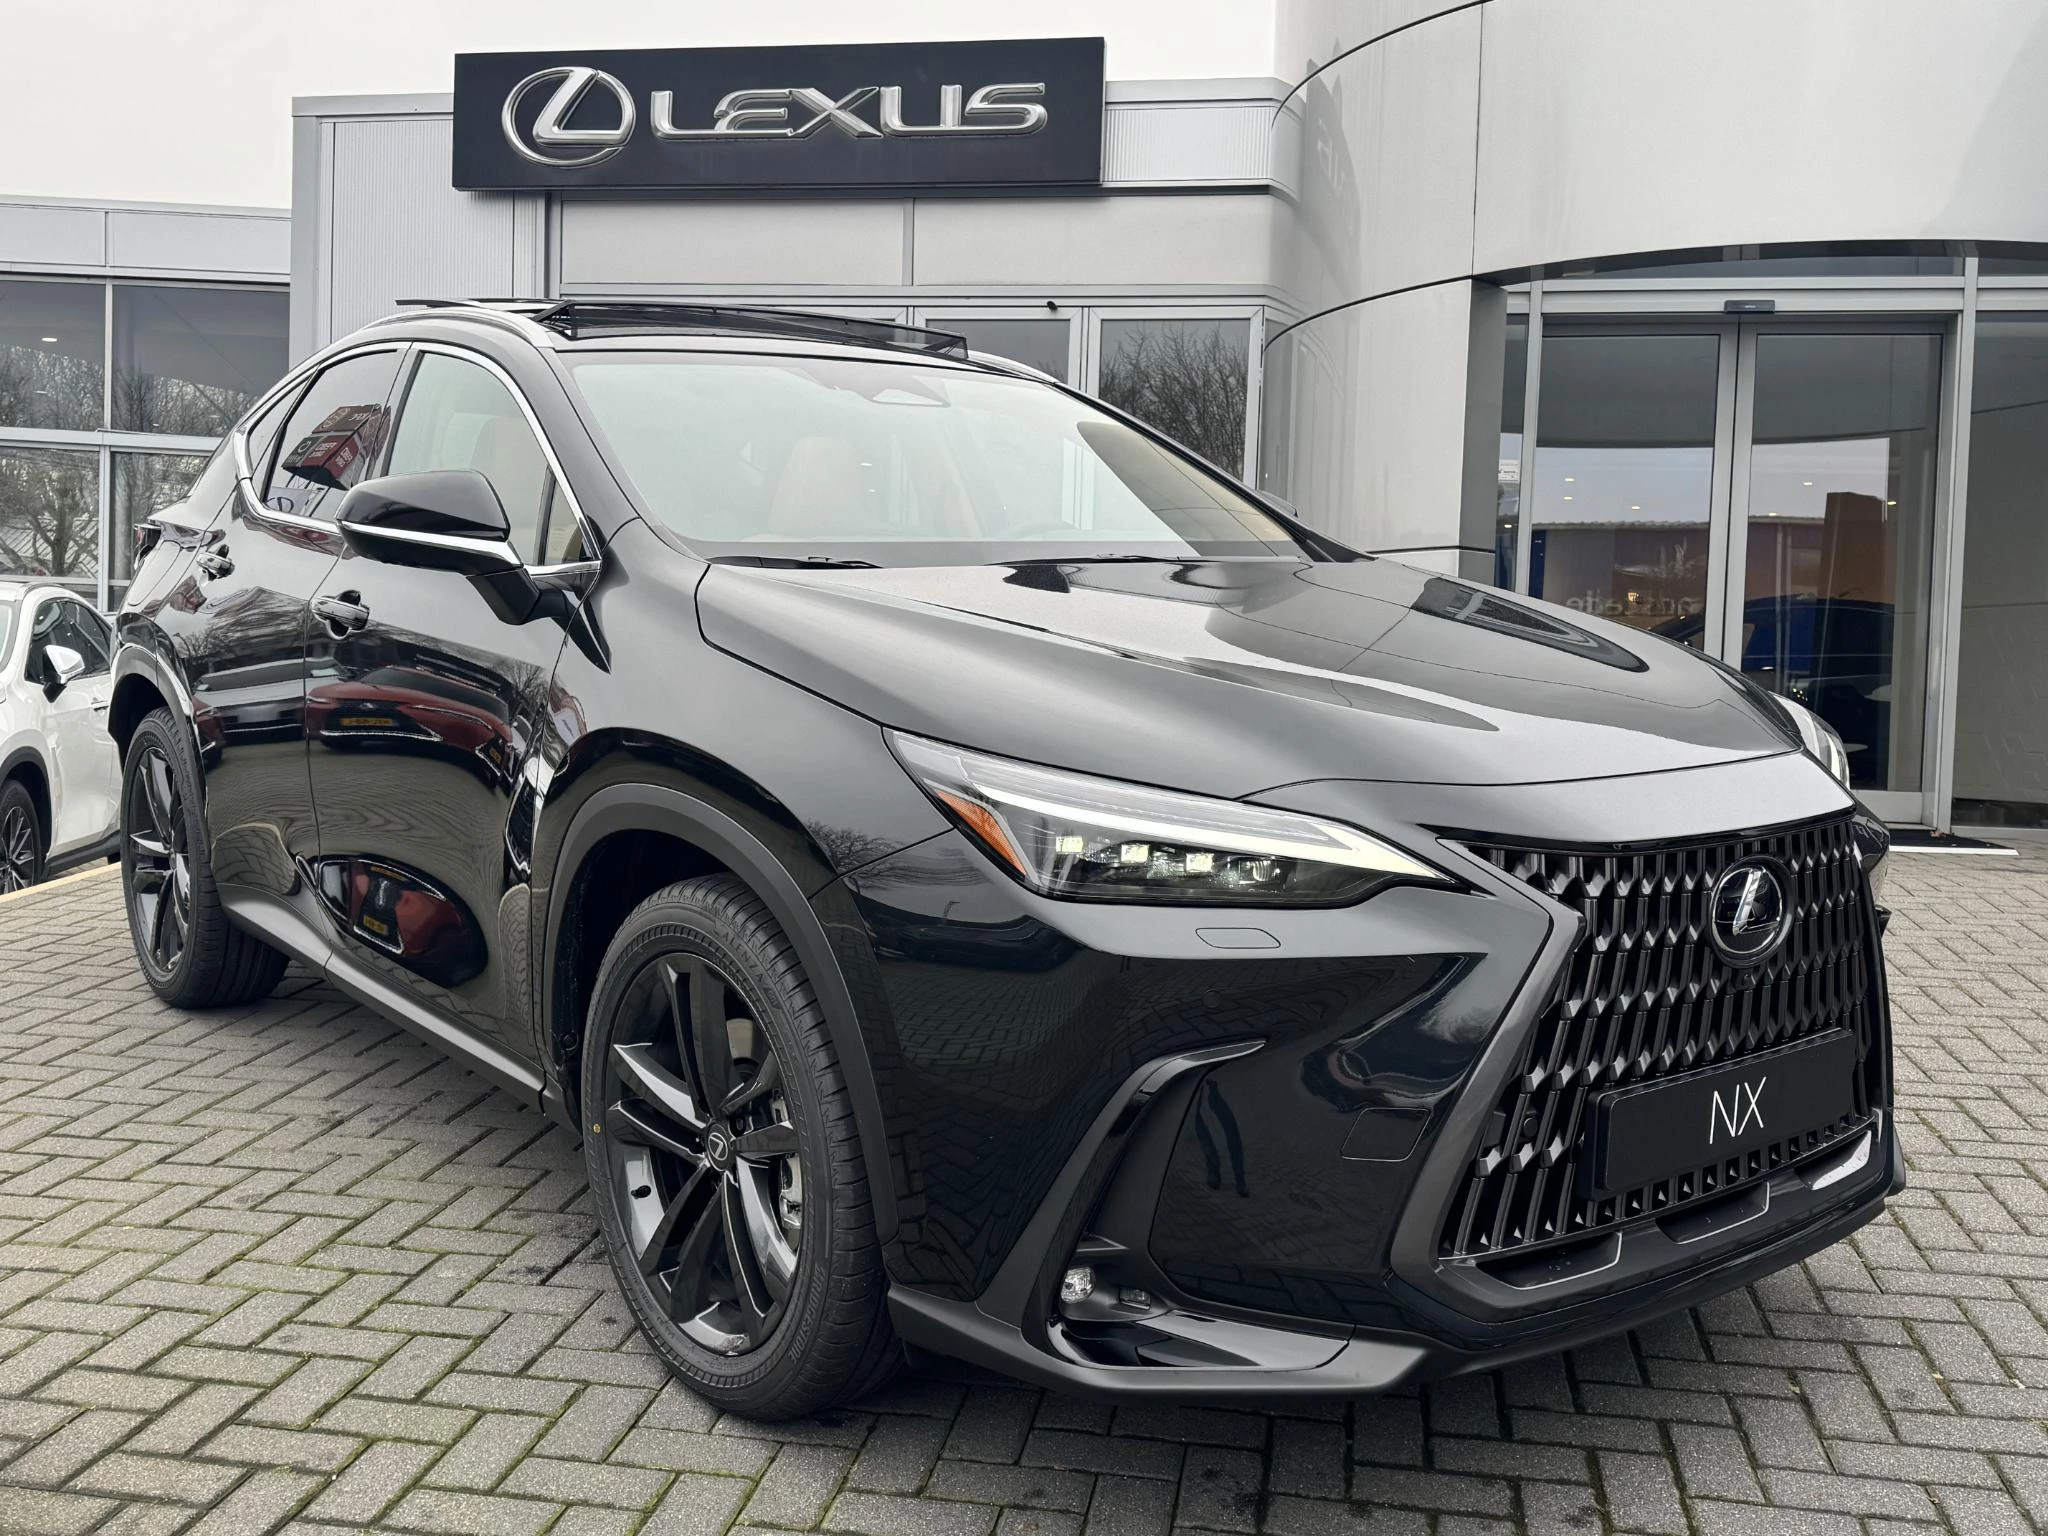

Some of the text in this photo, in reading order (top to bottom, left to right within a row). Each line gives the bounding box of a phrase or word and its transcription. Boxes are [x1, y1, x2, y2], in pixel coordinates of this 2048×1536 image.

[650, 82, 1048, 139] LEXUS
[721, 931, 764, 983] ALENZA
[1709, 1076, 1767, 1144] NX
[788, 1264, 826, 1364] BRIDGESTONE
